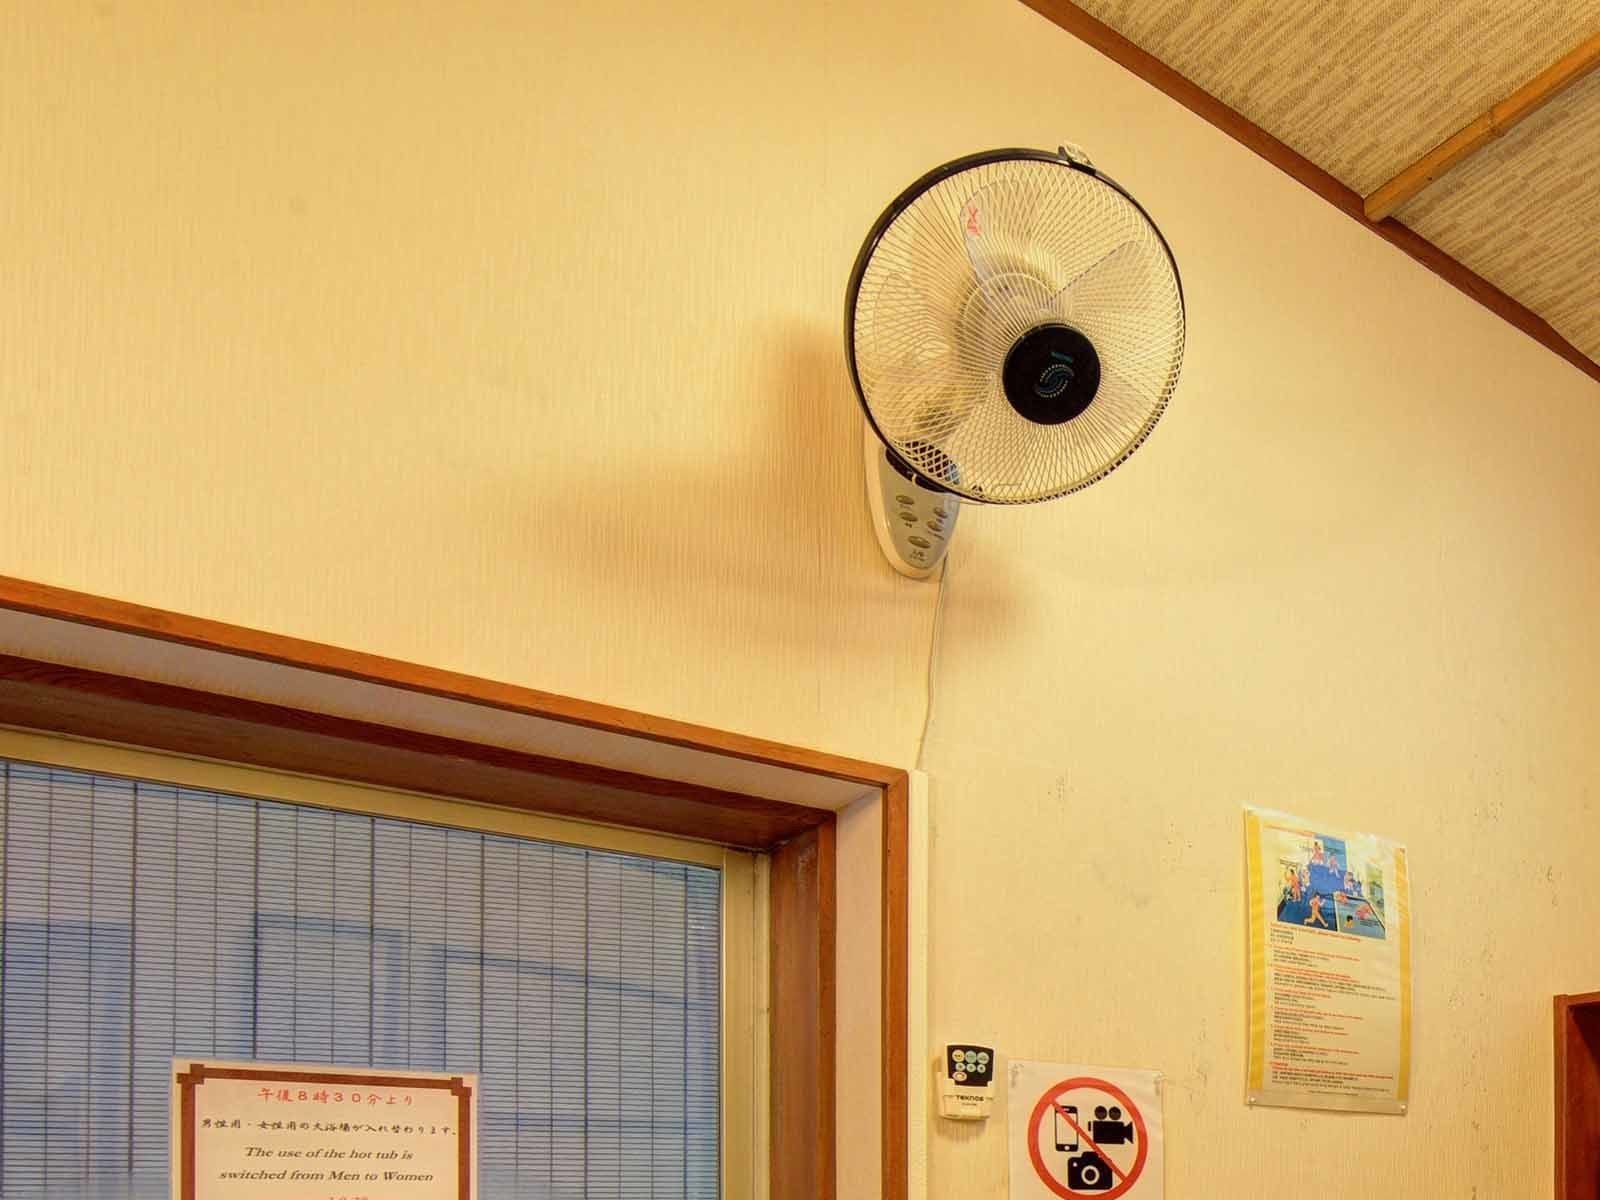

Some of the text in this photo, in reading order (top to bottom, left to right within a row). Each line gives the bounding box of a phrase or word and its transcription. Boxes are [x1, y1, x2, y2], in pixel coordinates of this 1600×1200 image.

[245, 1147, 414, 1161] The use of the hot tub is
[219, 1170, 434, 1182] switched from Men to Women
